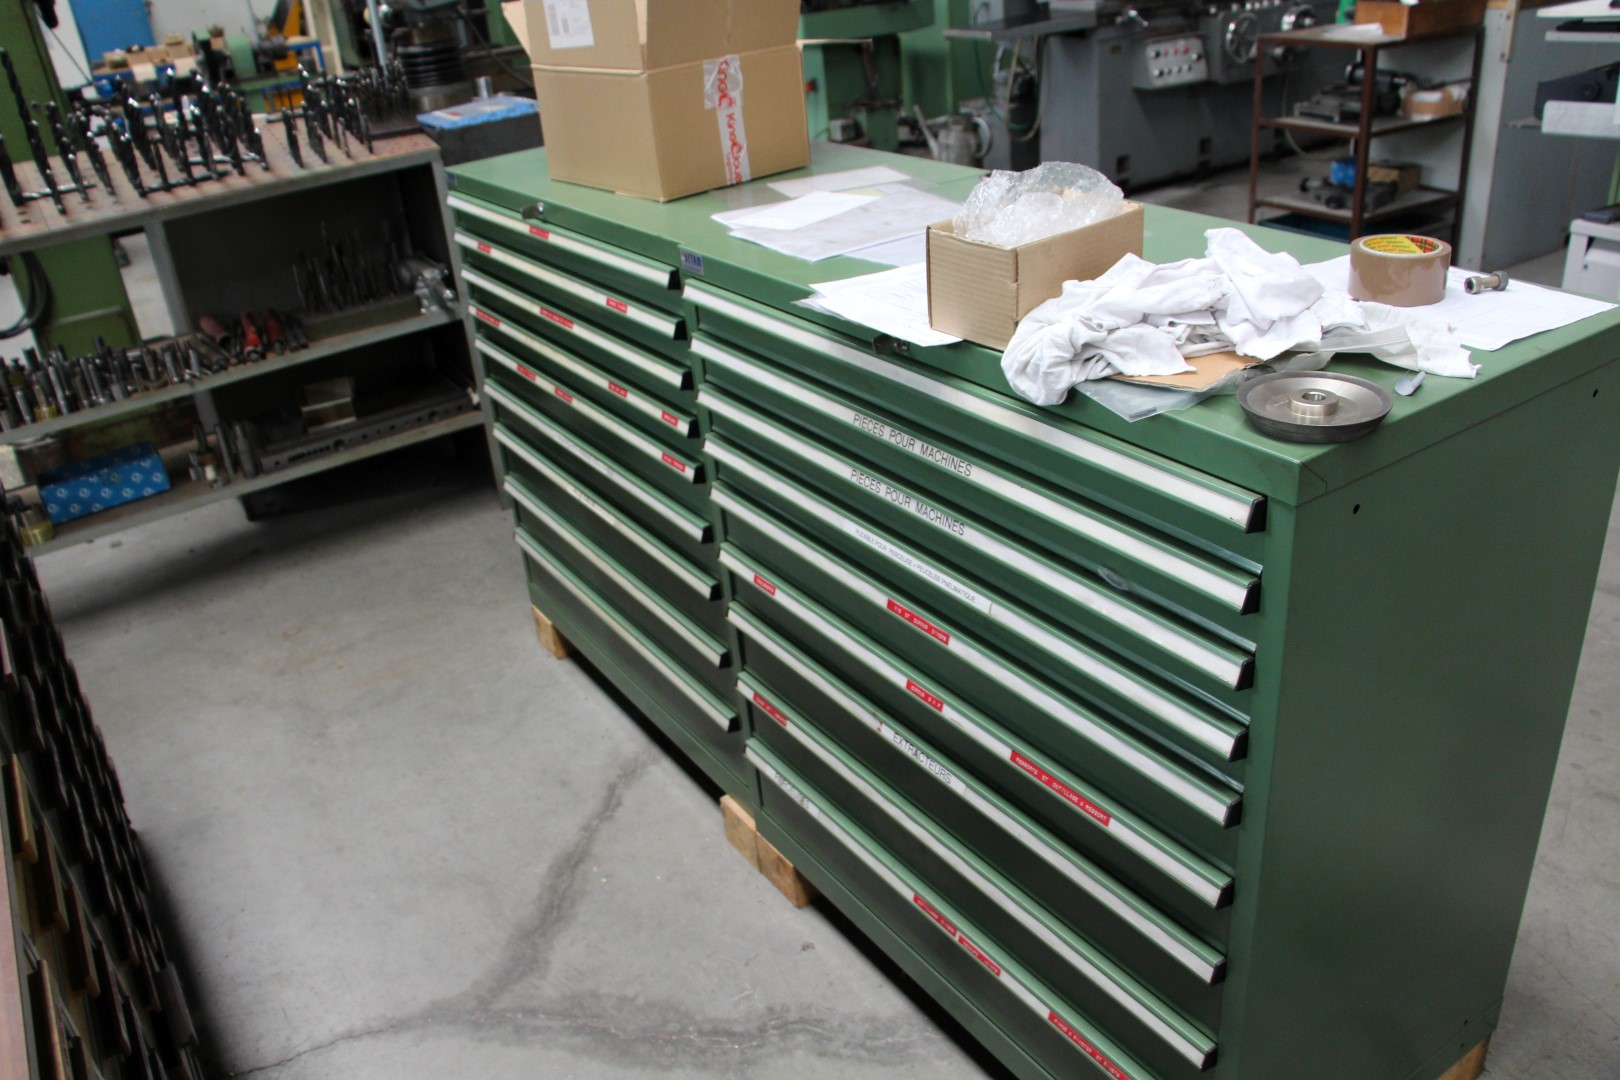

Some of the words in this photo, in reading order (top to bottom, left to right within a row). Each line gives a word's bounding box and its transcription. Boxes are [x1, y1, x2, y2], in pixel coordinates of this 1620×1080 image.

[853, 413, 885, 437] PIECES
[889, 429, 915, 451] POUR
[920, 443, 973, 477] MACHINES
[850, 469, 881, 493] PIECES
[885, 486, 911, 509] POUR
[915, 501, 965, 536] MACHINES
[941, 578, 976, 604] PNEUMATIQUE
[893, 732, 952, 784] EXTRACTEURS
[1015, 757, 1038, 775] RESSORTS
[1085, 804, 1107, 821] RESSORT
